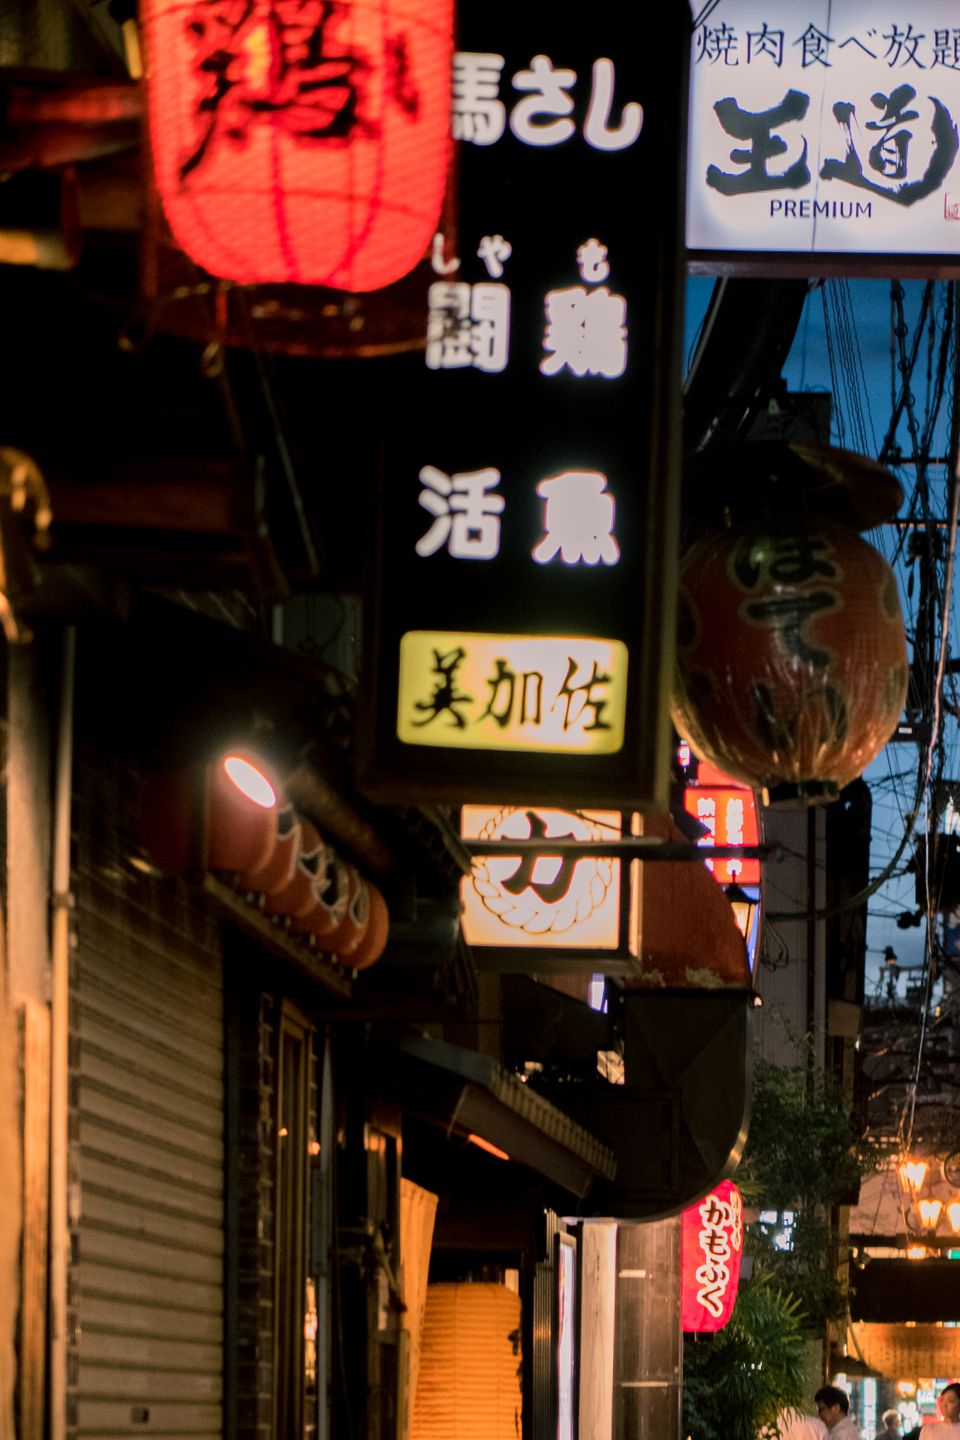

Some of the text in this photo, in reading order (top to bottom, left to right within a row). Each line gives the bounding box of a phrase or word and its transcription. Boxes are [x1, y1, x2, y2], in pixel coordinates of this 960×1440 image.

[451, 52, 643, 151] 馬さし
[706, 83, 959, 208] 王道
[769, 199, 872, 218] PREMIUM
[415, 465, 620, 567] 活魚
[410, 647, 614, 731] 美加佐
[697, 1196, 730, 1317] かもふく
